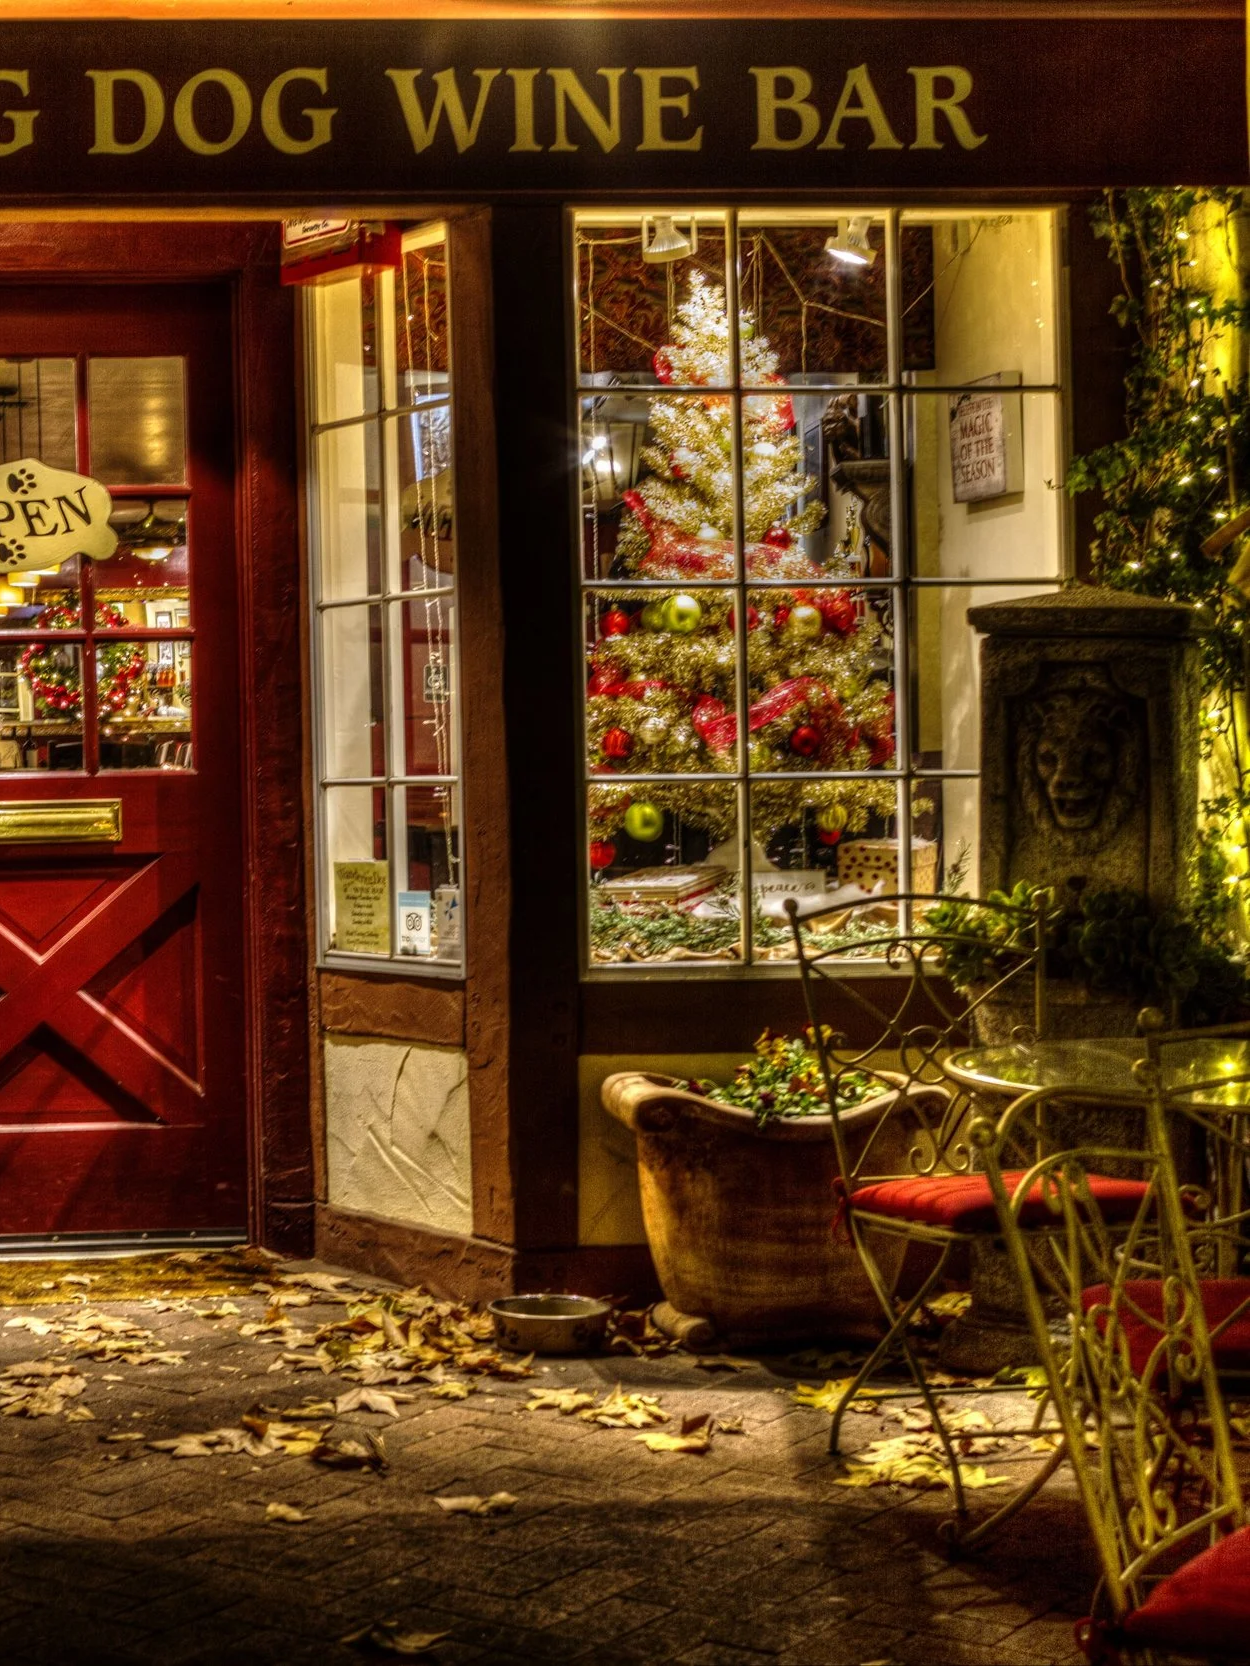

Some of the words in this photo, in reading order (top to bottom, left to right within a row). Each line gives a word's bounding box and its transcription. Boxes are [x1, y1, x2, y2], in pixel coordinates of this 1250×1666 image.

[85, 66, 339, 158] DOG
[383, 65, 705, 156] WINE
[747, 62, 989, 152] BAR
[959, 412, 994, 440] MAGIC
[959, 441, 973, 461] OF
[974, 436, 995, 456] THE
[960, 457, 997, 484] SEASON
